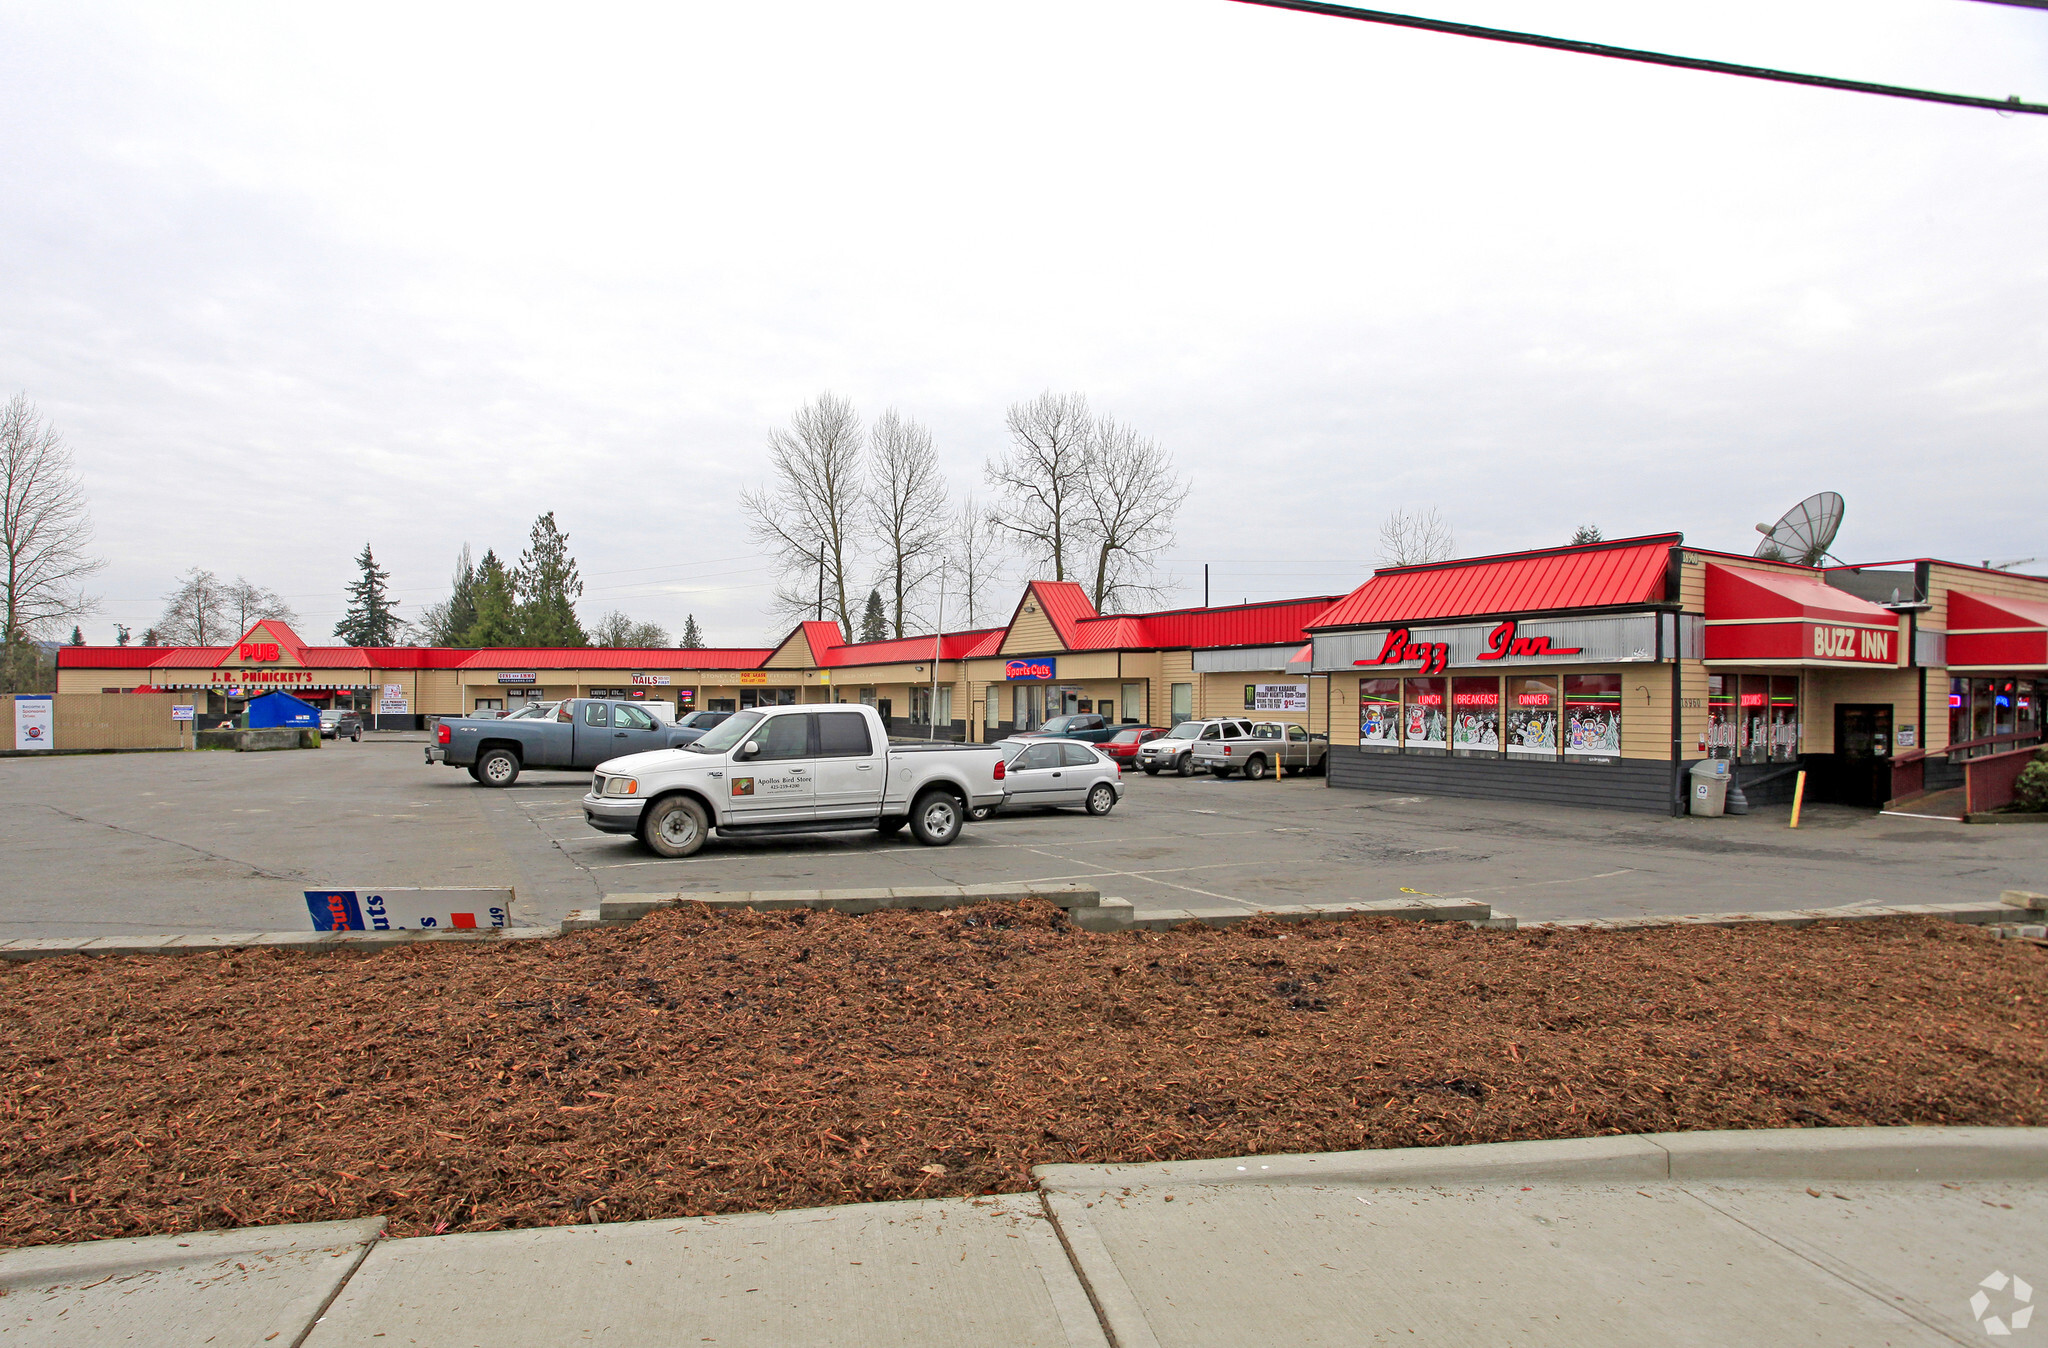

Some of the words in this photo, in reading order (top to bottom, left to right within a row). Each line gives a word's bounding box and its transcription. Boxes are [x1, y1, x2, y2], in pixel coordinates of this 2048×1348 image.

[1353, 628, 1449, 675] Buzz
[1476, 621, 1584, 661] Inn
[1814, 626, 1856, 657] BUZZ
[1861, 630, 1888, 660] INN
[239, 643, 280, 662] PUB
[242, 672, 313, 682] PHINICKEY'S
[632, 676, 658, 685] NAILS
[1418, 694, 1441, 704] LUNCH
[1457, 694, 1498, 704] BREAKFAST
[1518, 694, 1549, 705] DINNER
